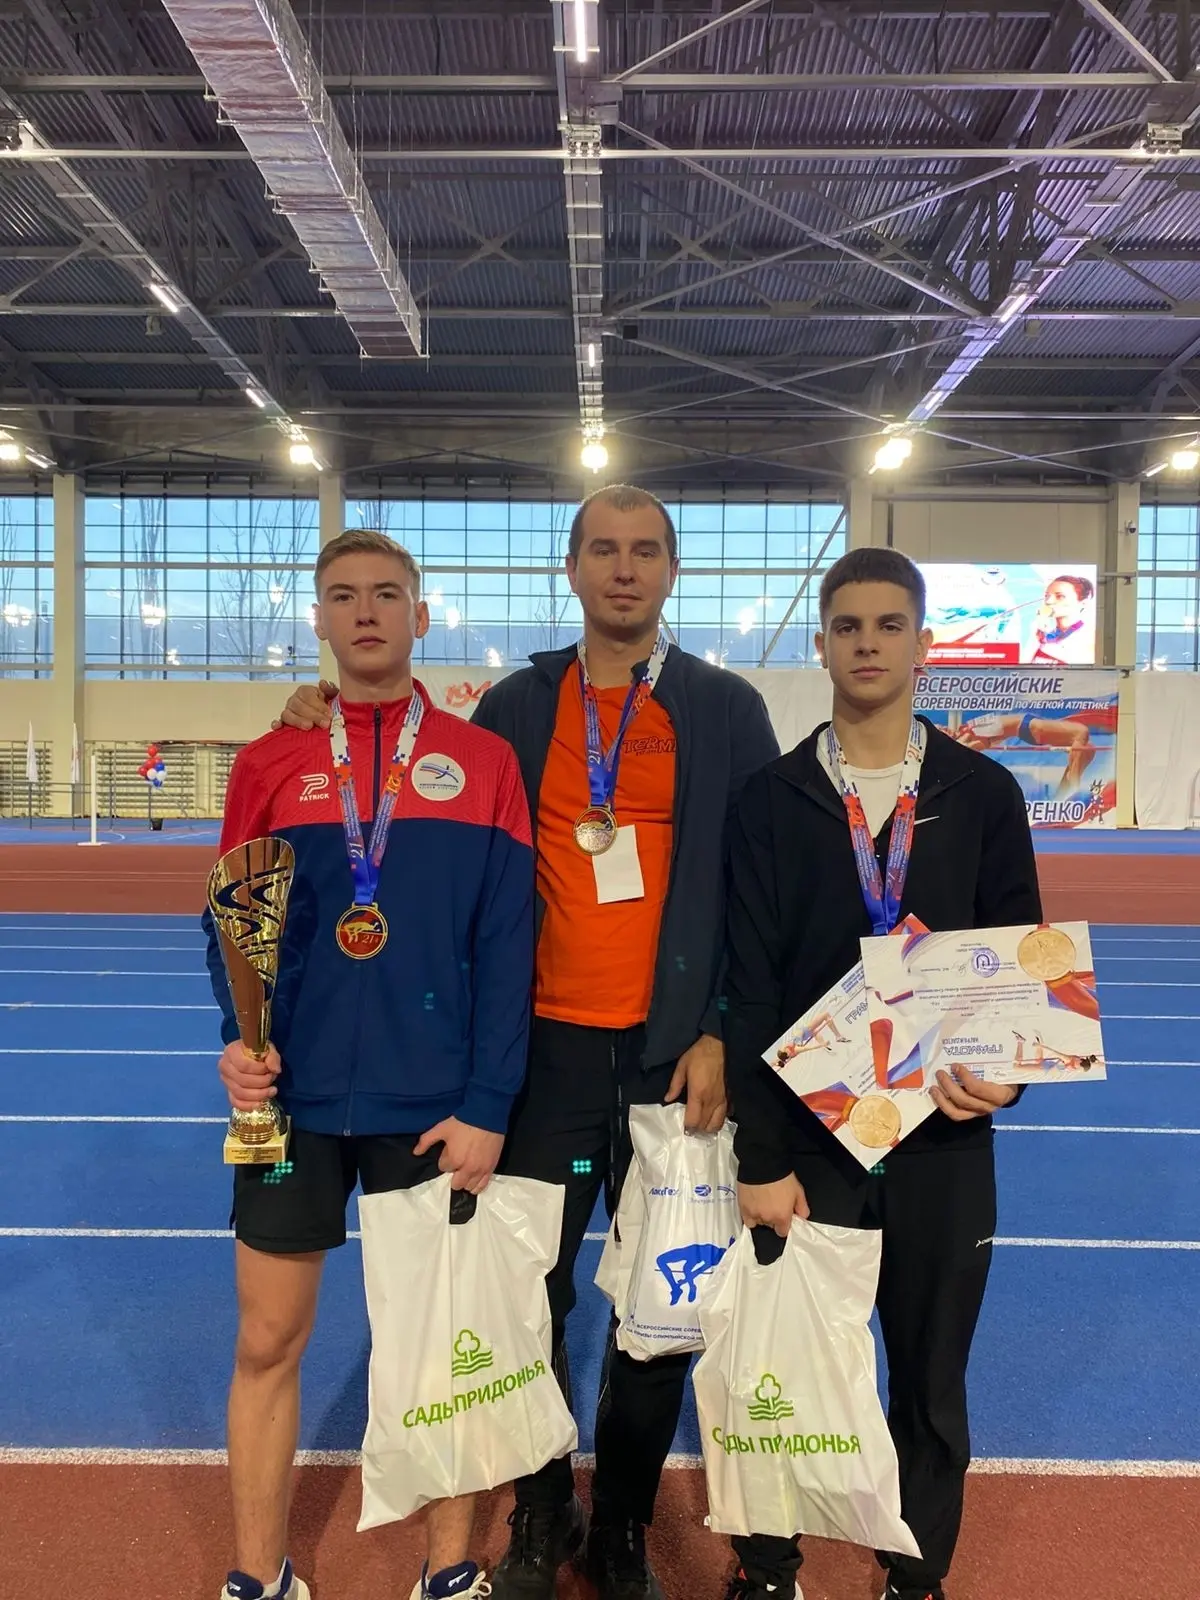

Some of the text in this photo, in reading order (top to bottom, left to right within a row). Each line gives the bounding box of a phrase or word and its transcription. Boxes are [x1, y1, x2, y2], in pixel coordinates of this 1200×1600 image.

[916, 673, 1064, 694] ВСЕРОССИЙСКИЕ
[912, 697, 1013, 710] СОРЕВНОВАНИЯ
[1065, 701, 1110, 710] АТЛЕТИКЕ
[624, 736, 675, 754] TERM
[588, 749, 601, 765] 21
[299, 793, 330, 802] PATRICK
[349, 842, 364, 860] 21
[943, 1043, 1004, 1056] ГРАМОТА
[636, 1324, 682, 1333] ВСЕРОССИЙСКИЕ
[454, 1359, 546, 1413] ПРИДОНЬЯ
[712, 1427, 755, 1455] СДЫ
